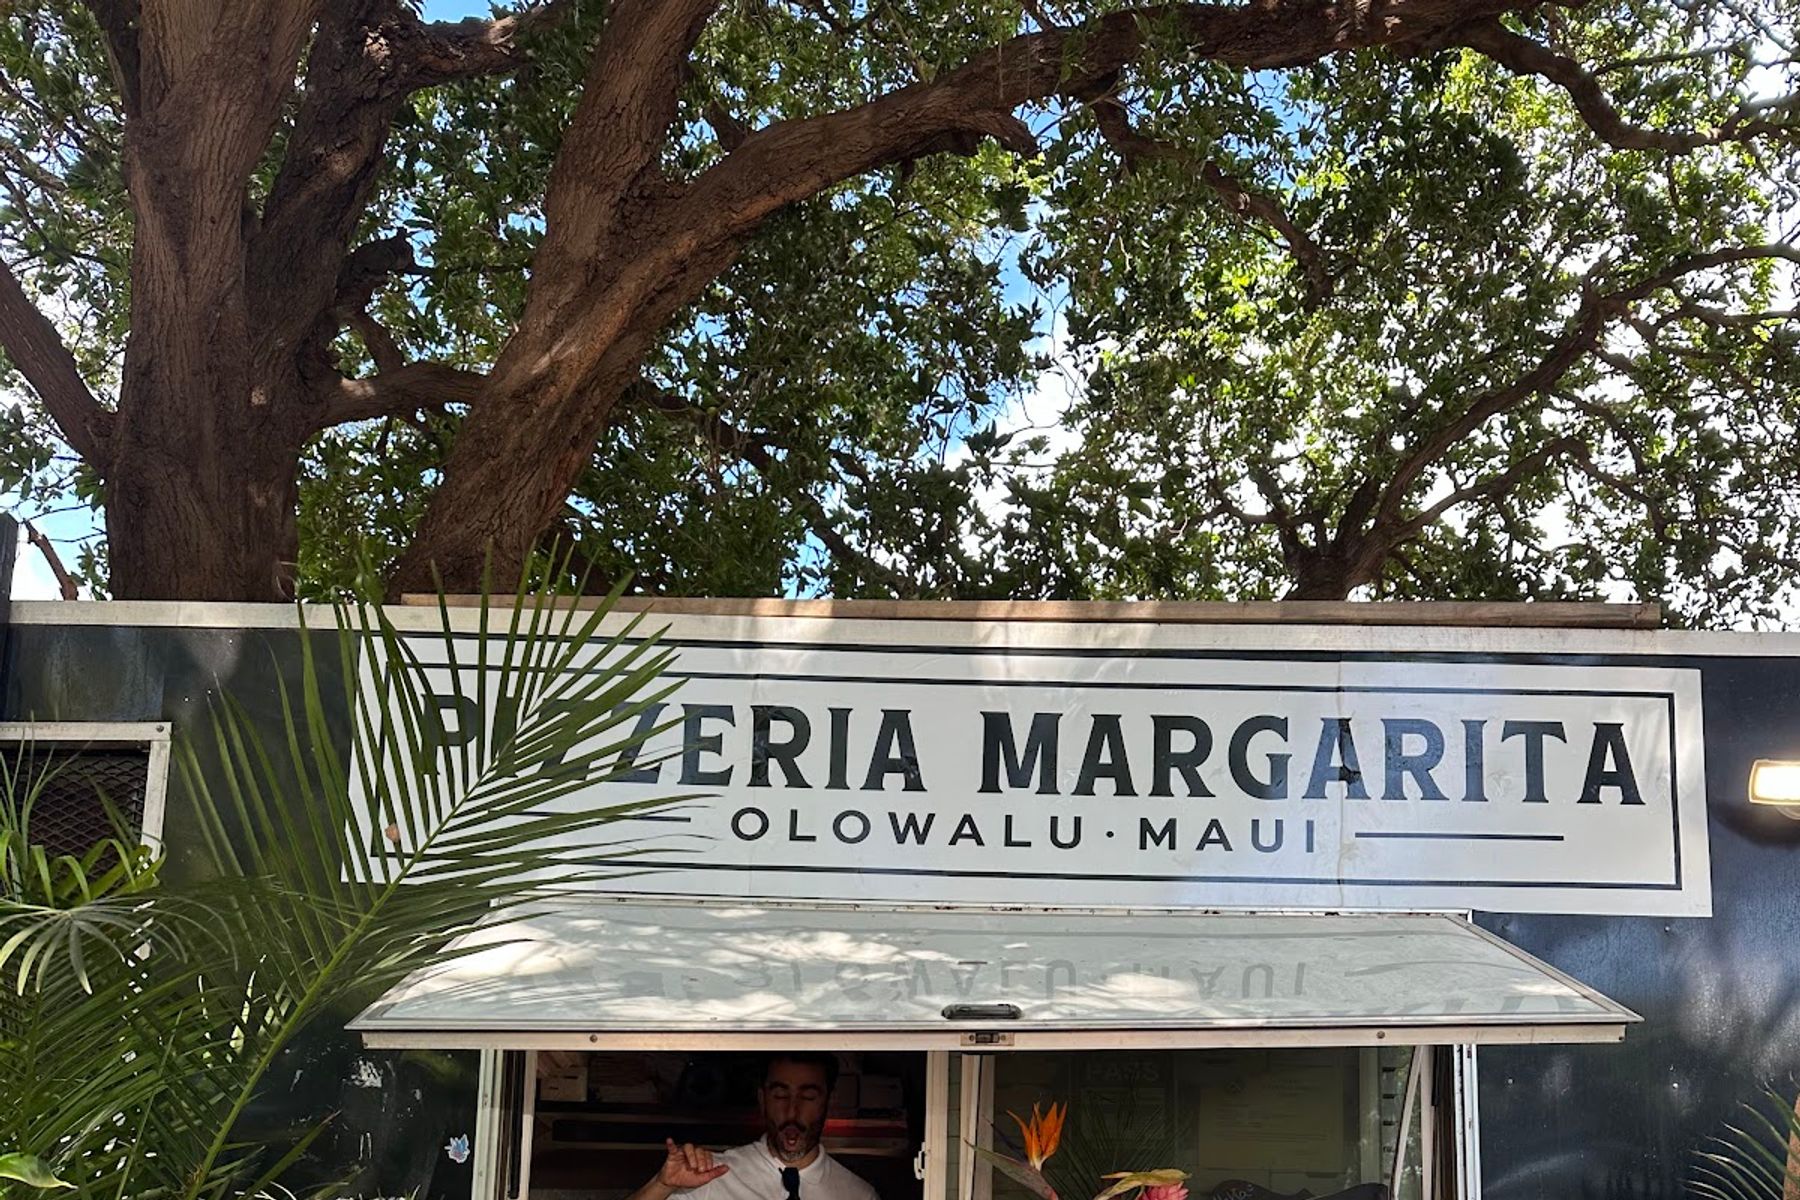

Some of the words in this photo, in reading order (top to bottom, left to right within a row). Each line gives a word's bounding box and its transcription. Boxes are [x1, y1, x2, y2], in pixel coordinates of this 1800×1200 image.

[421, 693, 927, 792] PZERIA
[980, 710, 1645, 807] MARGARITA
[731, 806, 1082, 849] OLOWALU
[1138, 816, 1315, 853] MAUI
